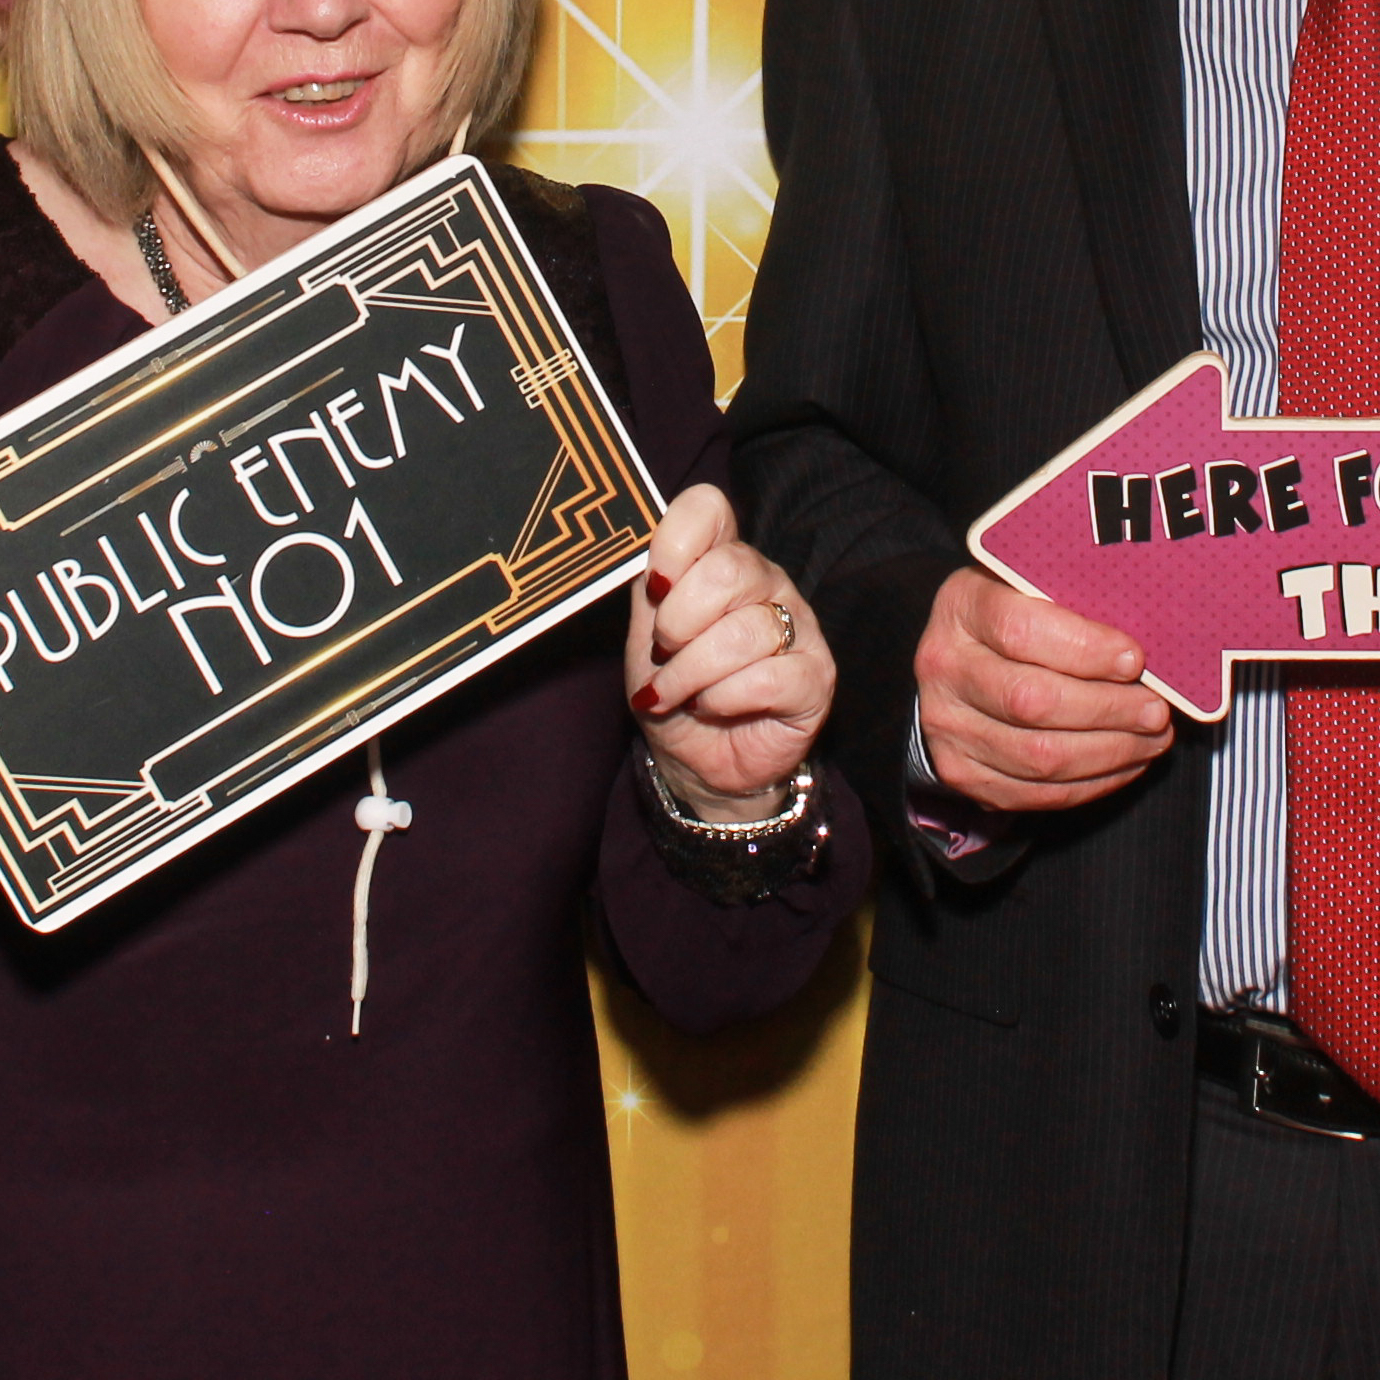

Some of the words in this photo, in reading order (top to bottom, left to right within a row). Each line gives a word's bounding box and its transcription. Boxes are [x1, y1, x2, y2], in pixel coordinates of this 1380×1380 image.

[229, 322, 486, 527] ENEMY
[1087, 455, 1310, 546] HERE
[166, 496, 404, 696] NO1
